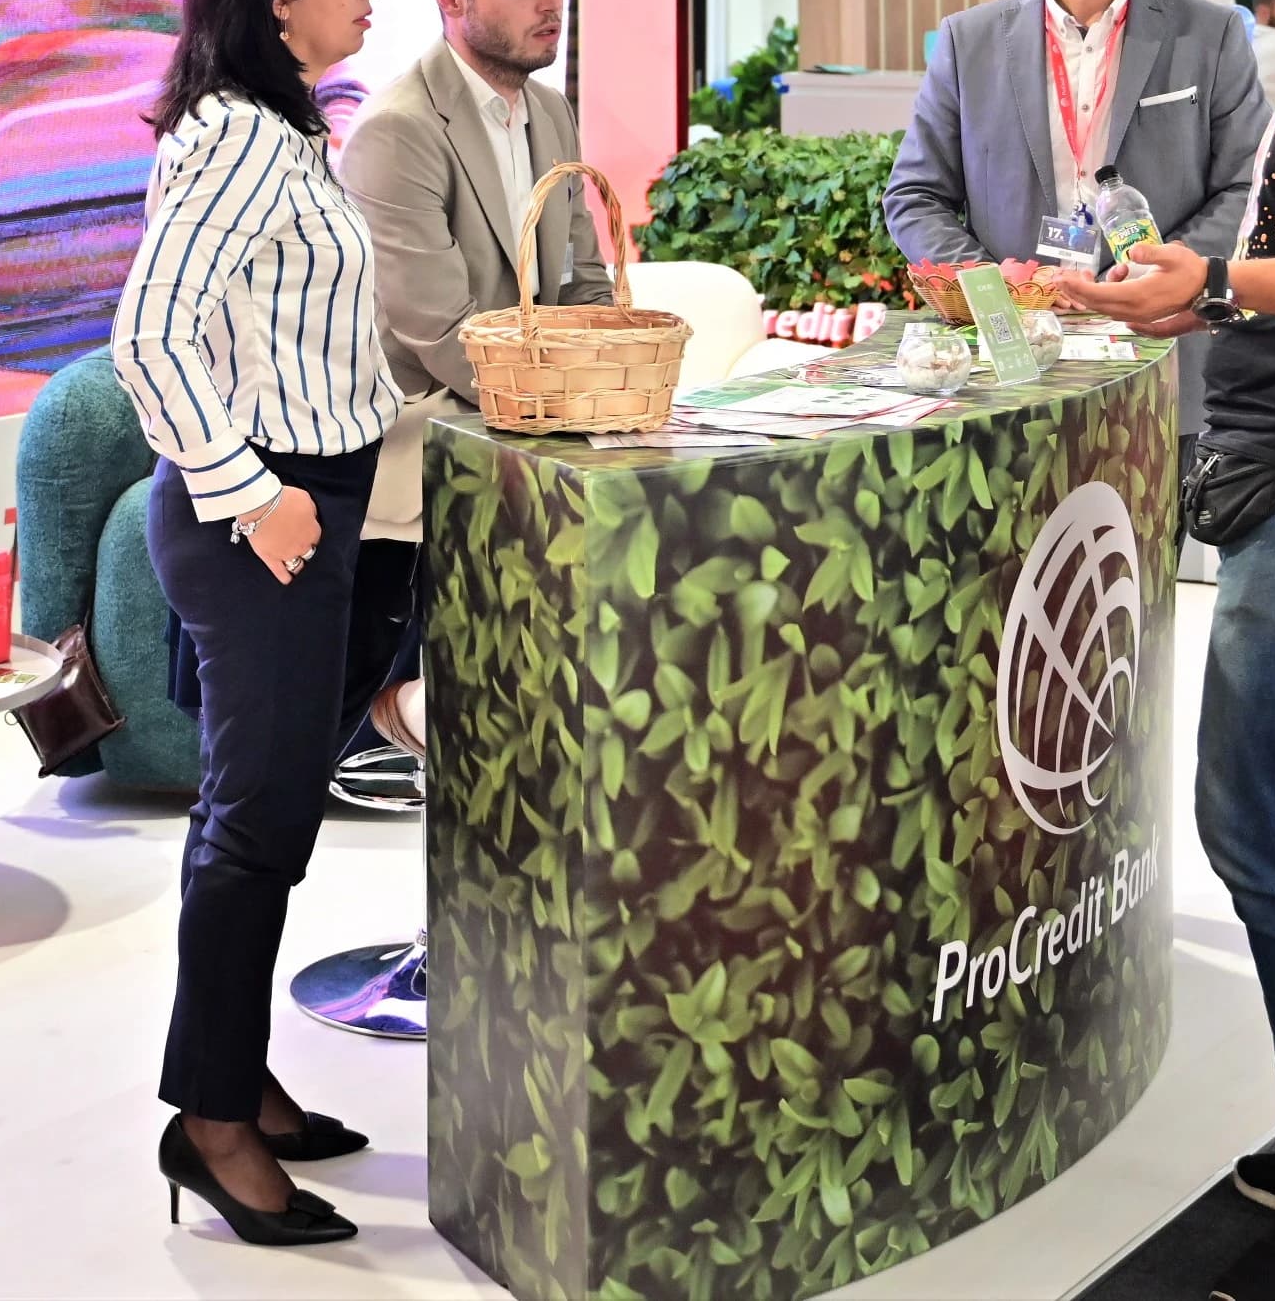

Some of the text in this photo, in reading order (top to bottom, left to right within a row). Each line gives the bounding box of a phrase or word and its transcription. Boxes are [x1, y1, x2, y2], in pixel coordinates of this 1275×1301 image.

[763, 301, 887, 343] redit B
[933, 823, 1160, 1023] ProCredit Bank
